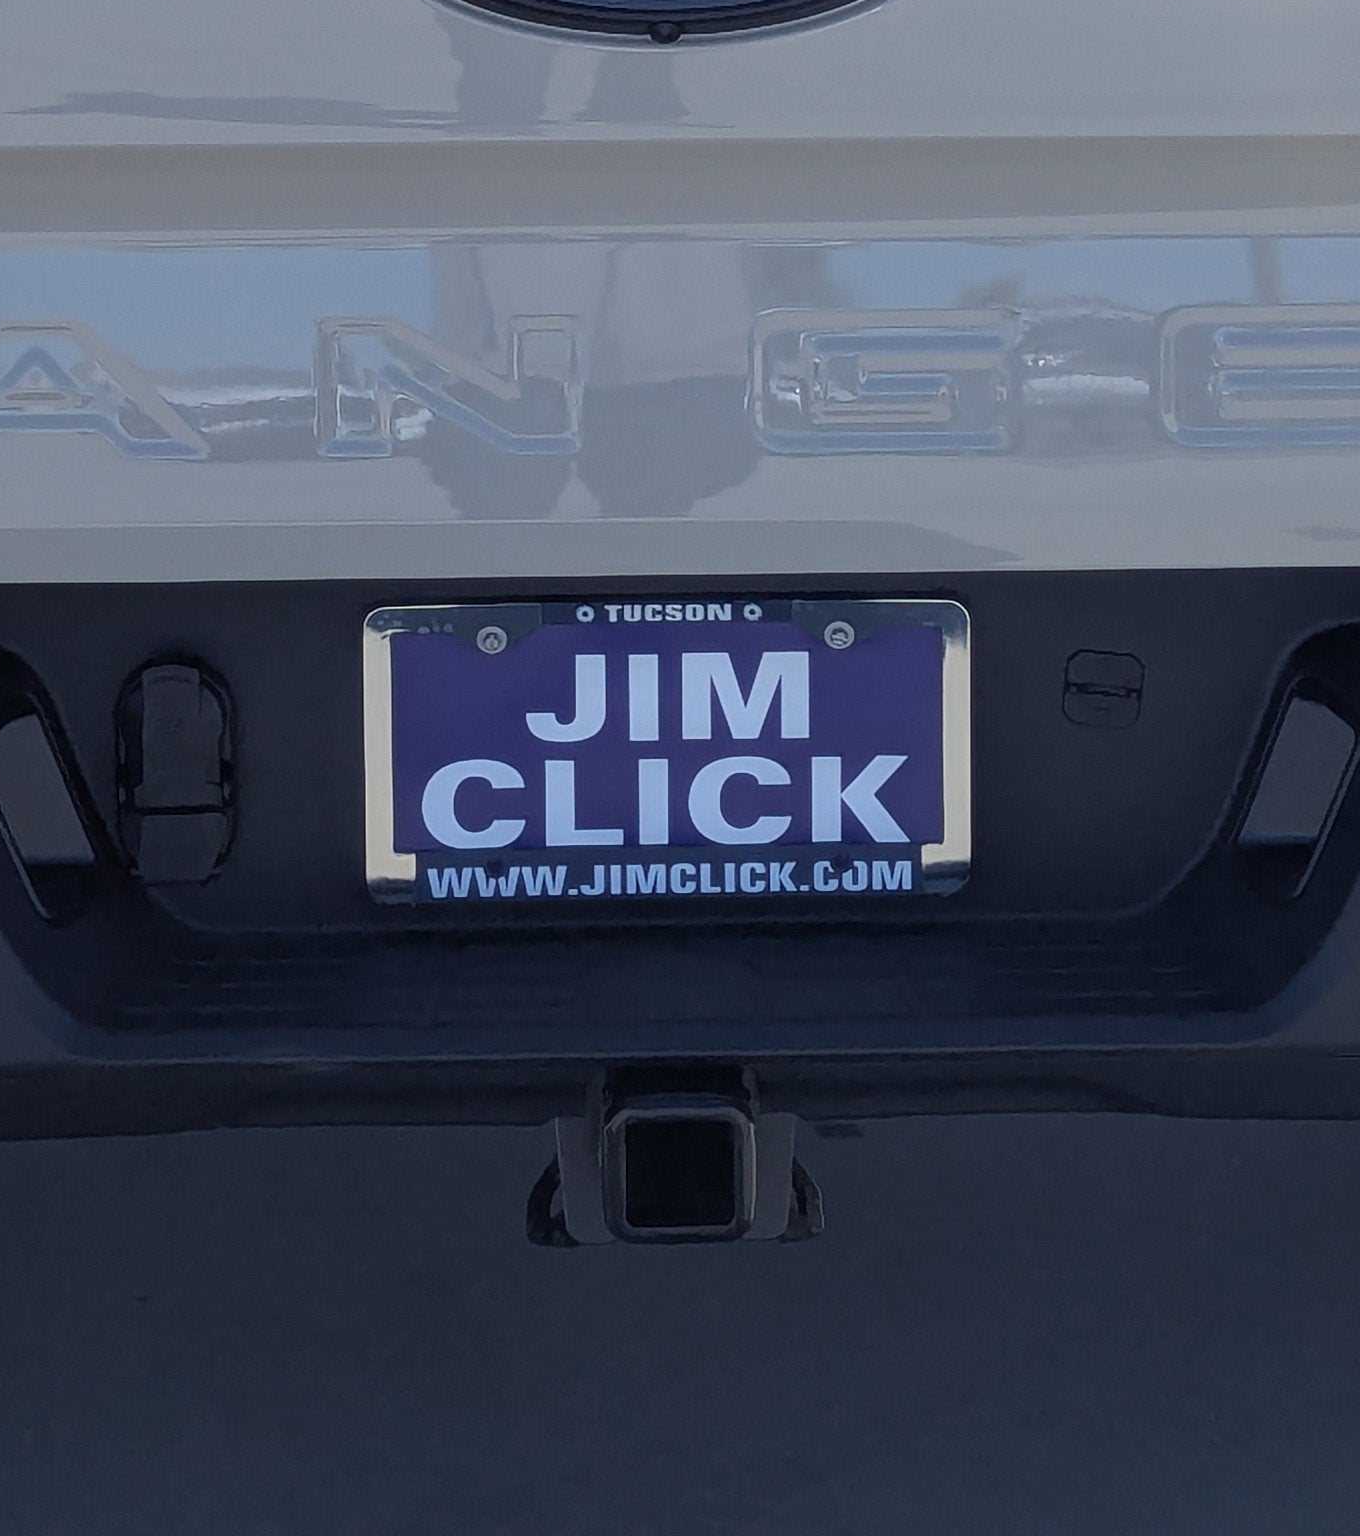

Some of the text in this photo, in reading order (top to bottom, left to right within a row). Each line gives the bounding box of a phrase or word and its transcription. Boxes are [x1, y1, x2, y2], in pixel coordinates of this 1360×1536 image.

[603, 604, 733, 622] TUCSON
[525, 651, 811, 742] JIM
[421, 755, 911, 850] CLICK
[426, 860, 913, 900] WWW.JIMCLICK.COM
